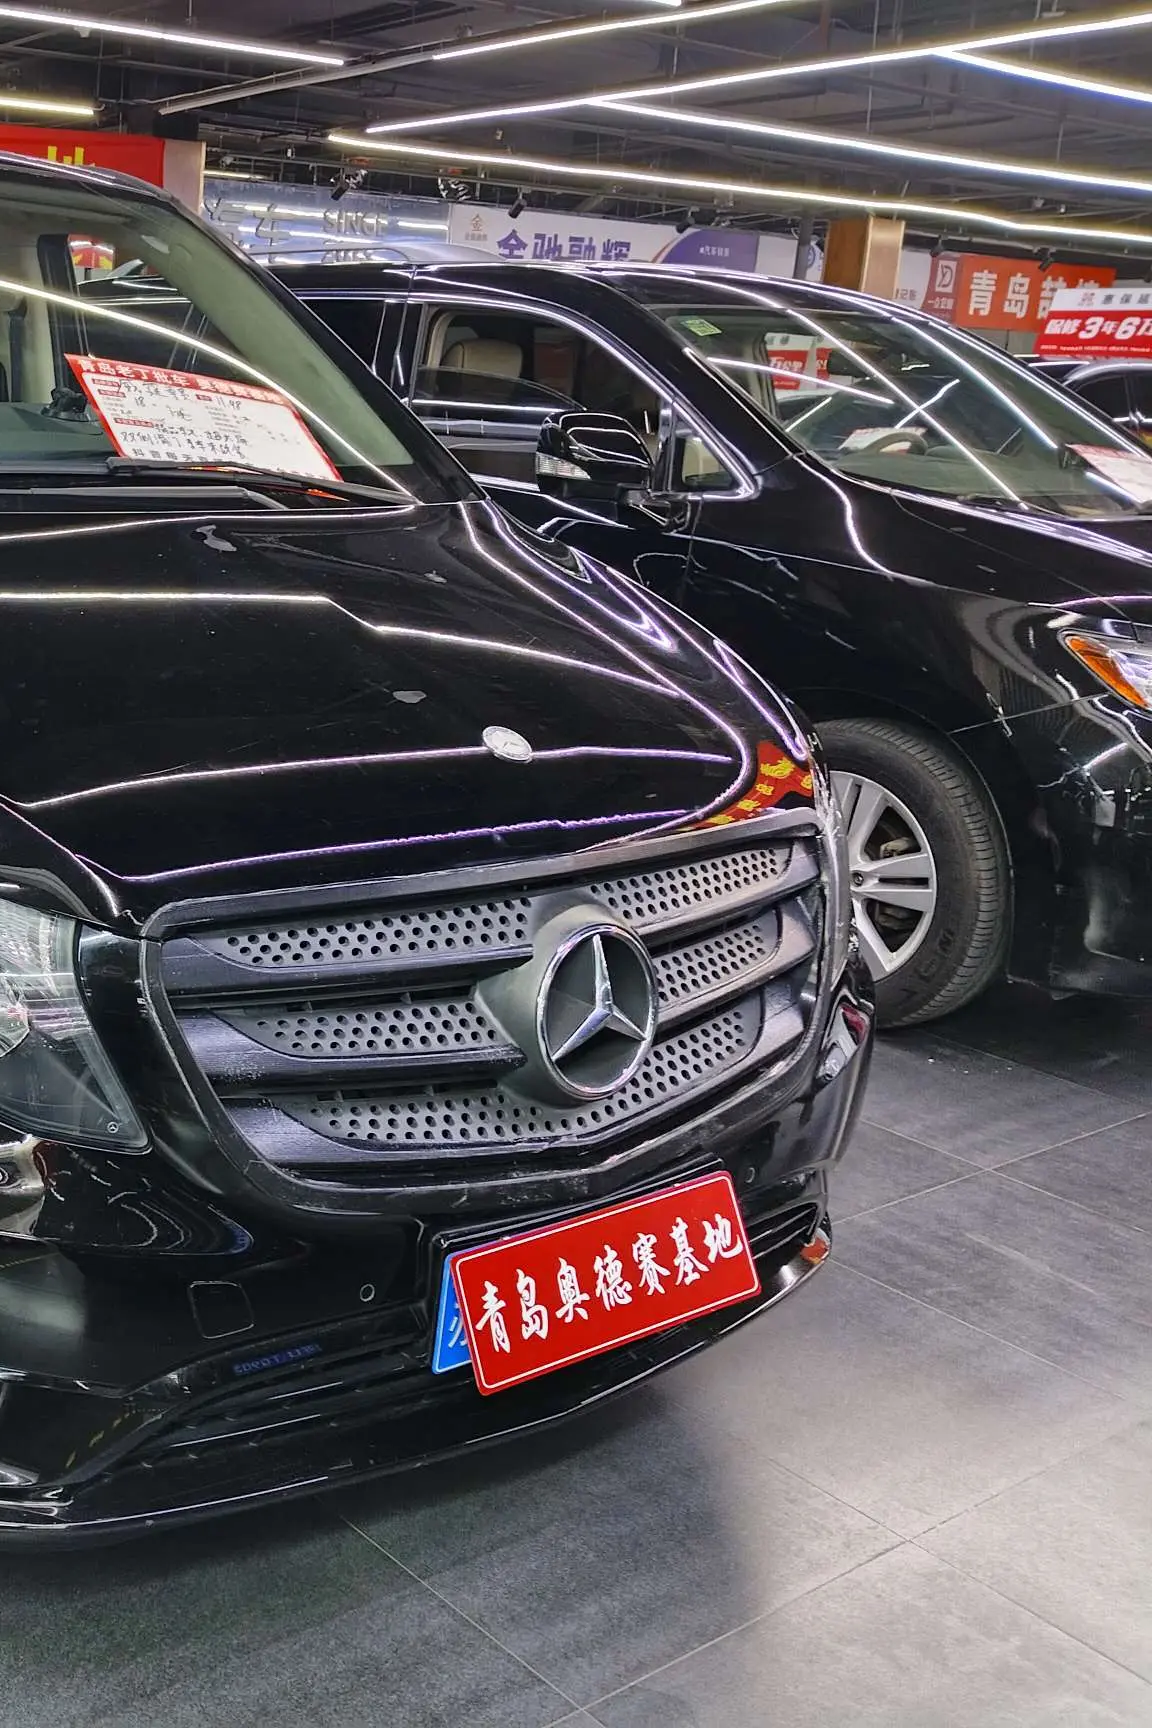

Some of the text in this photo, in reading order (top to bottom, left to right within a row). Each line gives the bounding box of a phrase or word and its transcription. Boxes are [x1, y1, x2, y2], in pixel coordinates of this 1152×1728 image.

[475, 1212, 744, 1354] 青岛奥德赛基地
